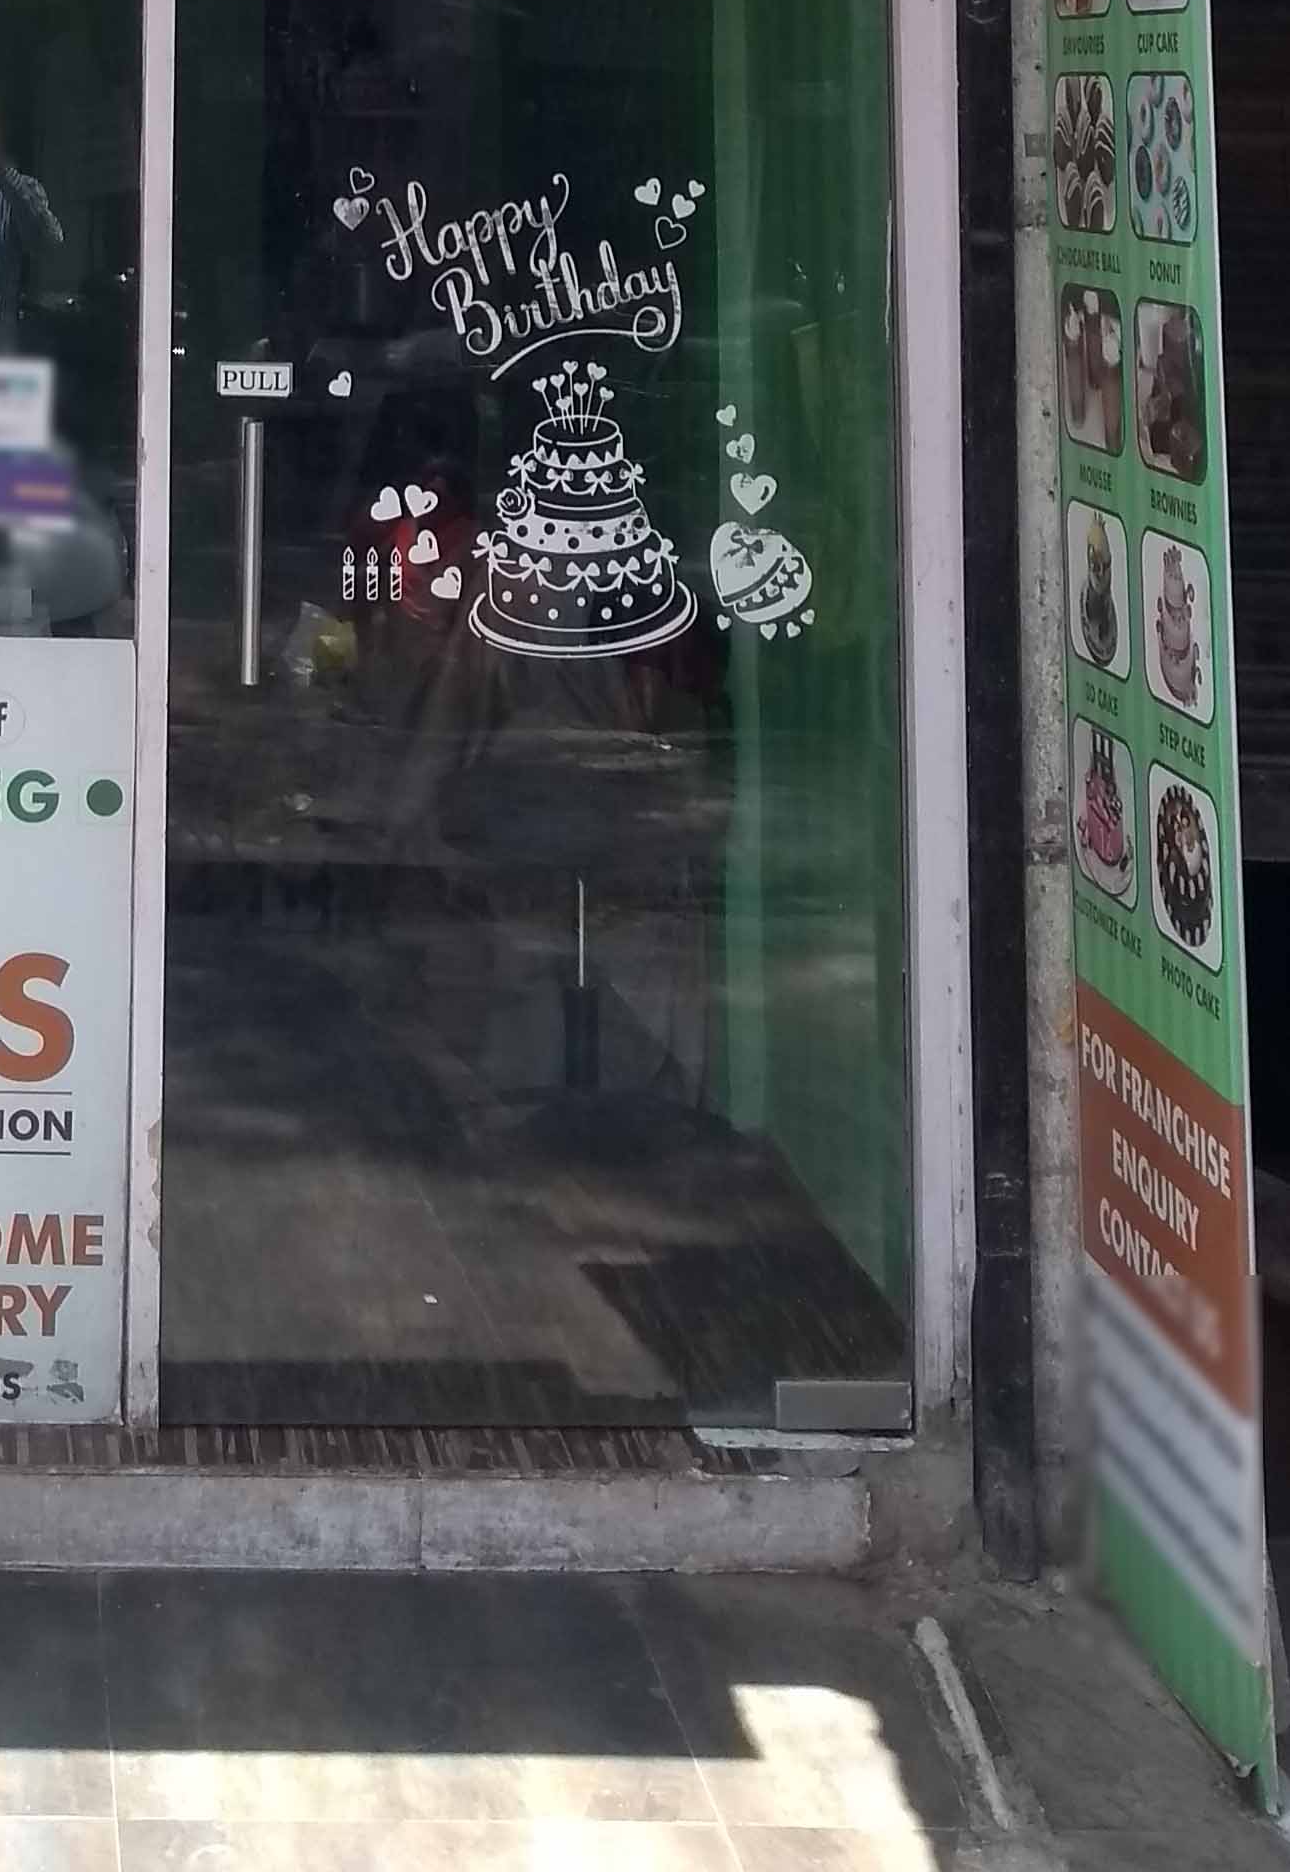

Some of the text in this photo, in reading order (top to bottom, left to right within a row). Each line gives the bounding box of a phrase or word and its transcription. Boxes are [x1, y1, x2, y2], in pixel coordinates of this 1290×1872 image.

[1137, 31, 1179, 55] CUP CAKE
[375, 172, 570, 288] Happy
[1149, 258, 1181, 286] DONUT
[430, 240, 681, 355] Birthday
[222, 369, 289, 392] PULL
[1149, 488, 1198, 525] BROWNIES
[1097, 687, 1119, 717] CAKE
[1158, 722, 1206, 769] STEP CAKE
[1120, 925, 1143, 959] CAKE
[1160, 955, 1221, 1021] PHOTO CAKE
[1081, 1023, 1232, 1201] FOR FRANCHISE
[1112, 1127, 1200, 1253] ENQUIRY
